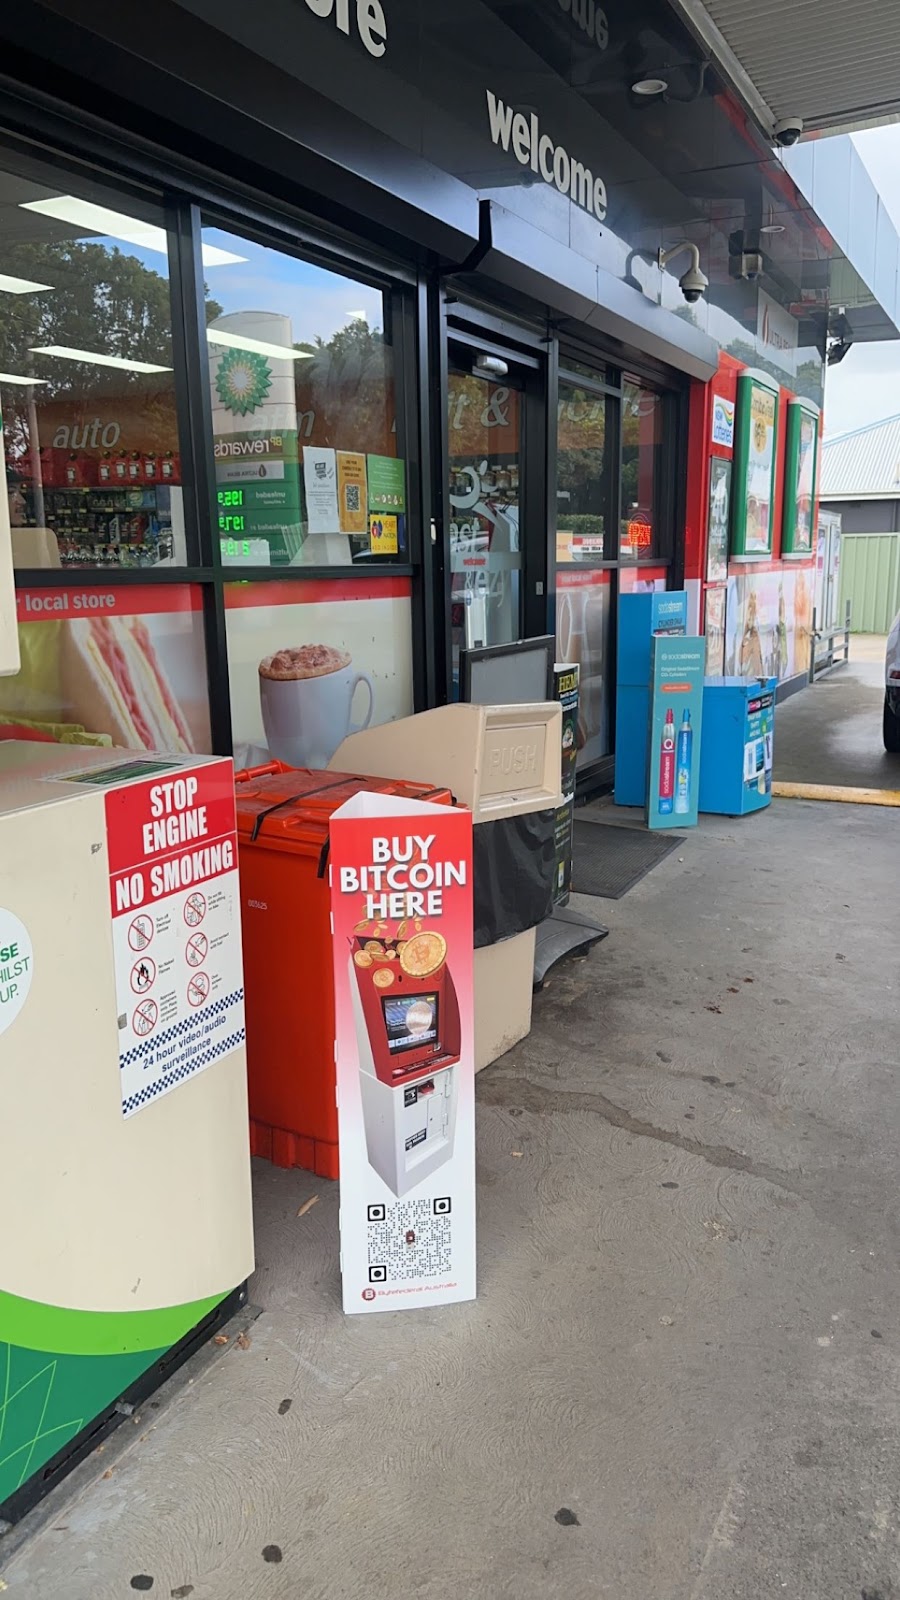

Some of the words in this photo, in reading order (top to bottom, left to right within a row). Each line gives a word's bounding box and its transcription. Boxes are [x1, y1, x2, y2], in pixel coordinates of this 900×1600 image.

[486, 89, 607, 221] welcome
[52, 418, 121, 449] auto
[25, 593, 69, 611] local
[73, 593, 116, 610] store
[488, 744, 538, 777] PUSH
[150, 776, 198, 817] STOP
[142, 806, 208, 855] ENGINE
[372, 834, 437, 863] BUY
[115, 872, 145, 911] NO
[150, 840, 233, 897] SMOKING
[339, 860, 467, 893] BITCOIN
[366, 889, 443, 919] HERE
[143, 1055, 154, 1070] 24
[156, 1043, 177, 1062] hour
[178, 1015, 227, 1049] video/audio
[161, 1037, 211, 1073] surveillance
[424, 1282, 458, 1291] Australia
